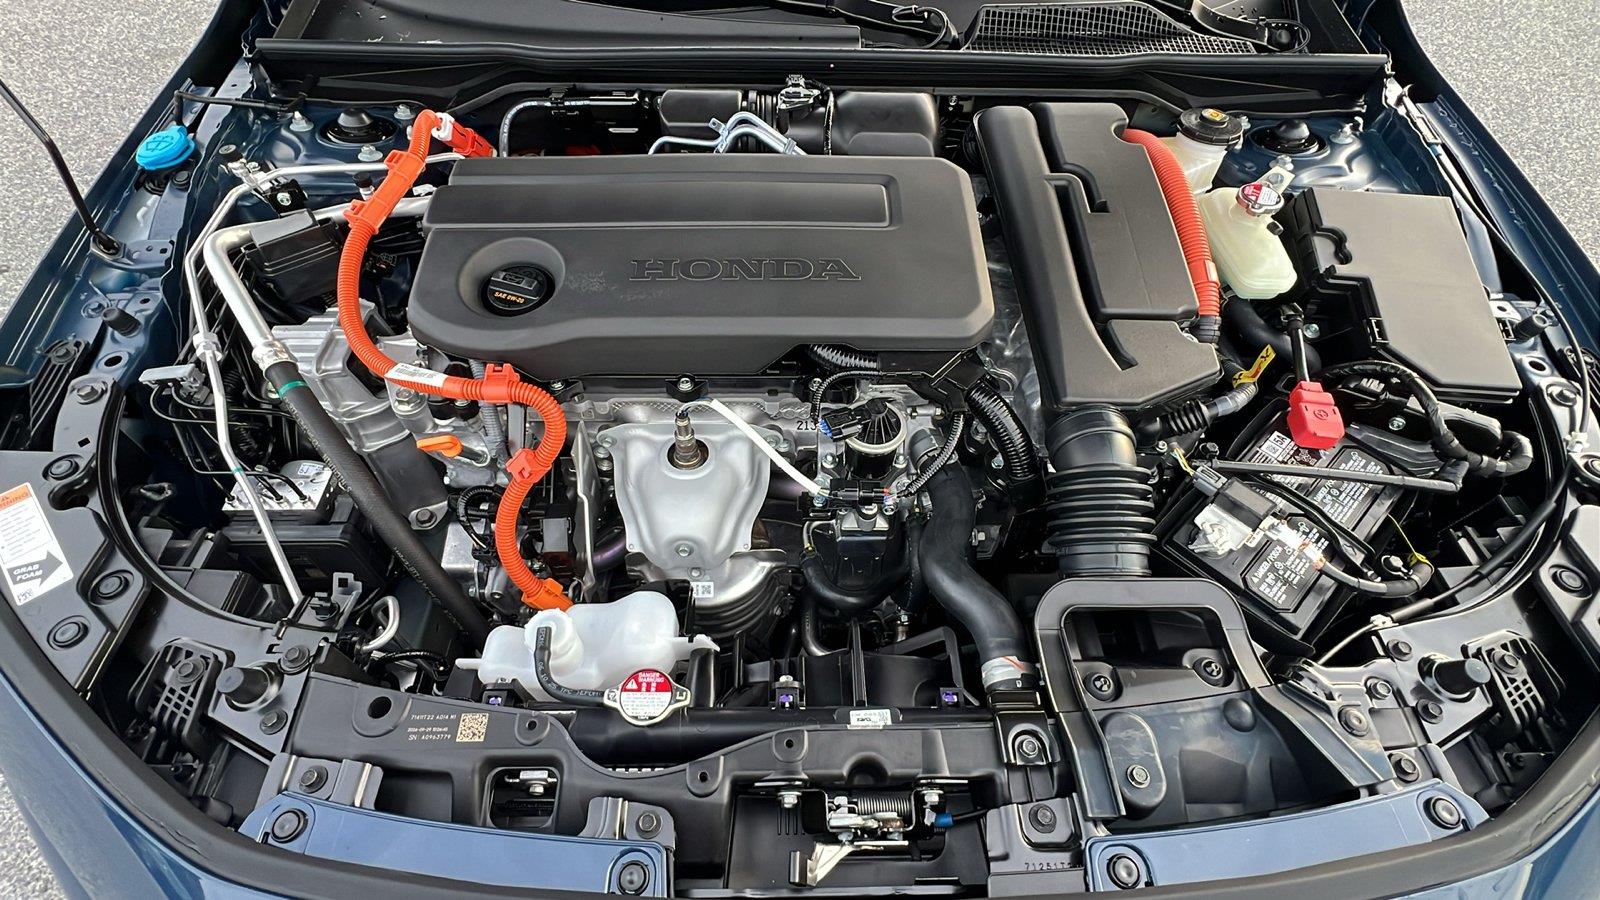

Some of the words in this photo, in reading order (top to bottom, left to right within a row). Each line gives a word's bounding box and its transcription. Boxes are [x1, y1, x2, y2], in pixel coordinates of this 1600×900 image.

[629, 258, 861, 281] HONDA
[13, 563, 39, 575] GRAB
[16, 570, 43, 582] FOAM
